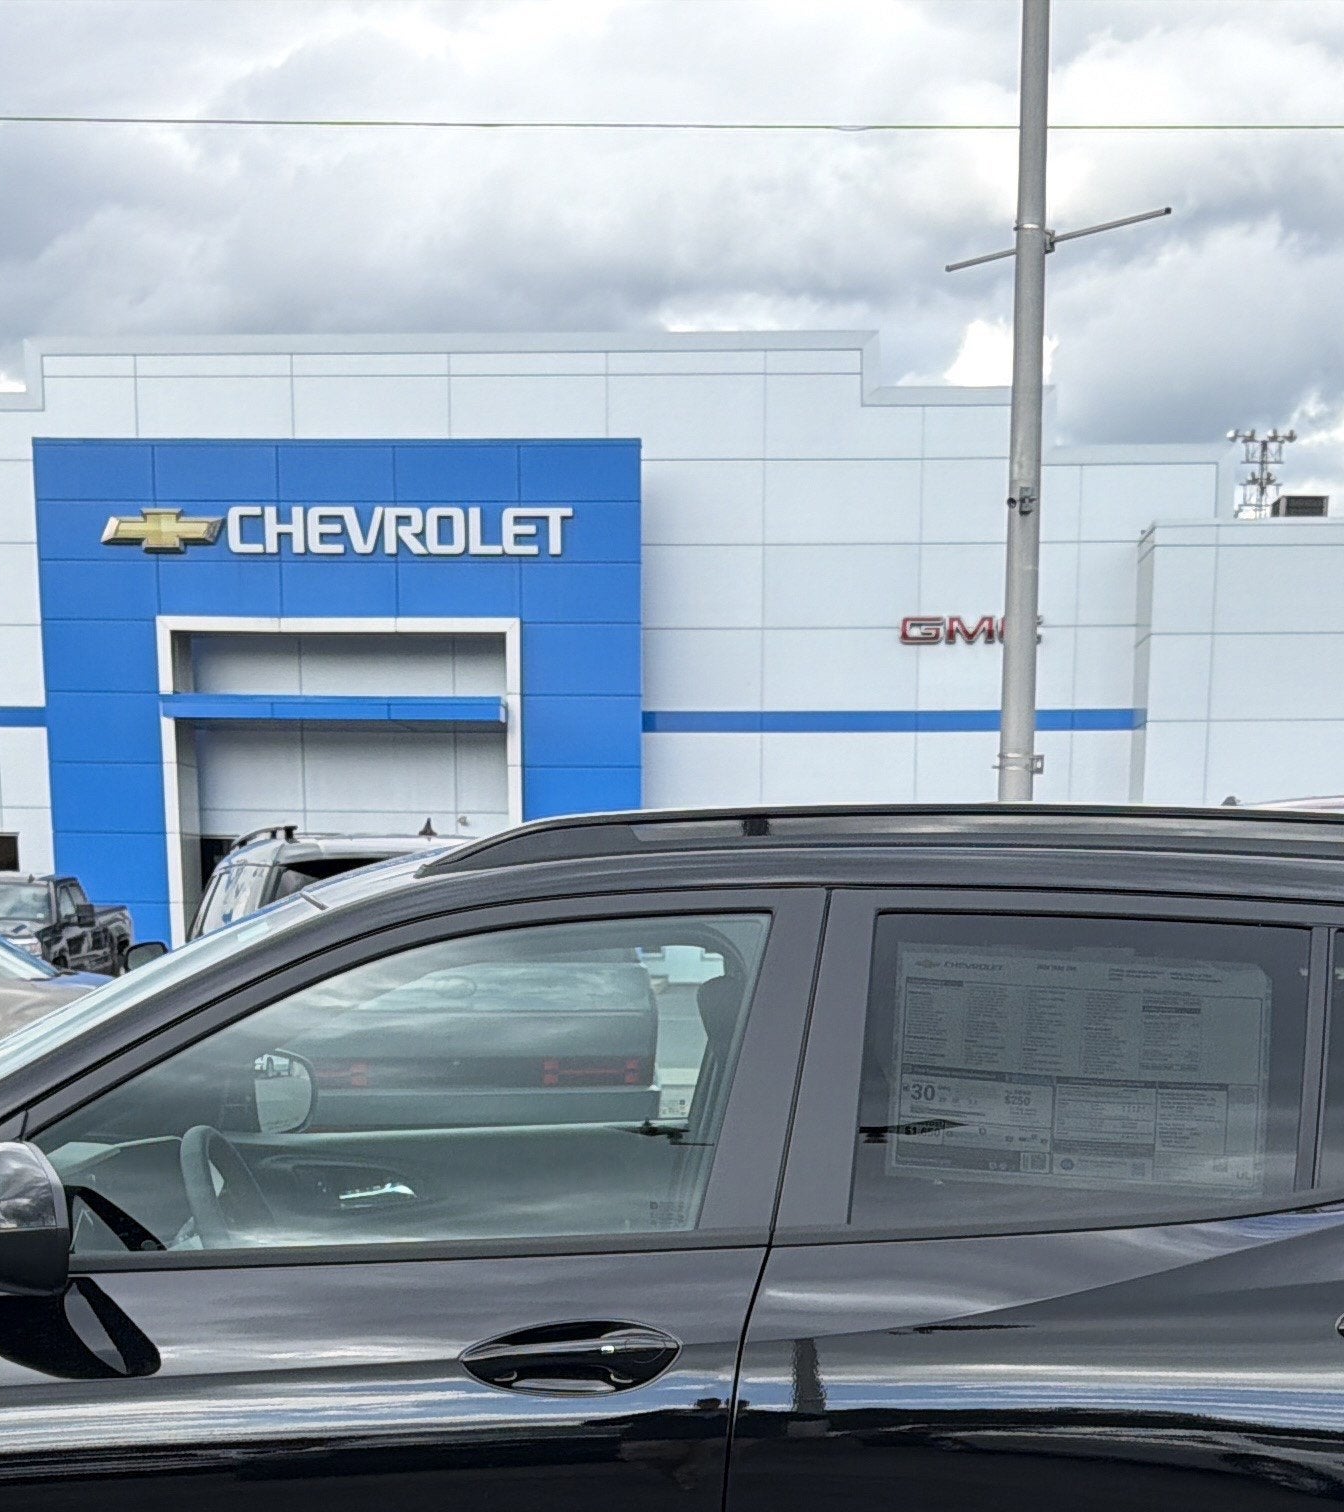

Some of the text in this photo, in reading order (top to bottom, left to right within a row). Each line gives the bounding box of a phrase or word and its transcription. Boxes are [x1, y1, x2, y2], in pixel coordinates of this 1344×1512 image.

[226, 506, 573, 556] CHEVROLET
[900, 615, 1043, 646] GM
[910, 1083, 936, 1101] 30
